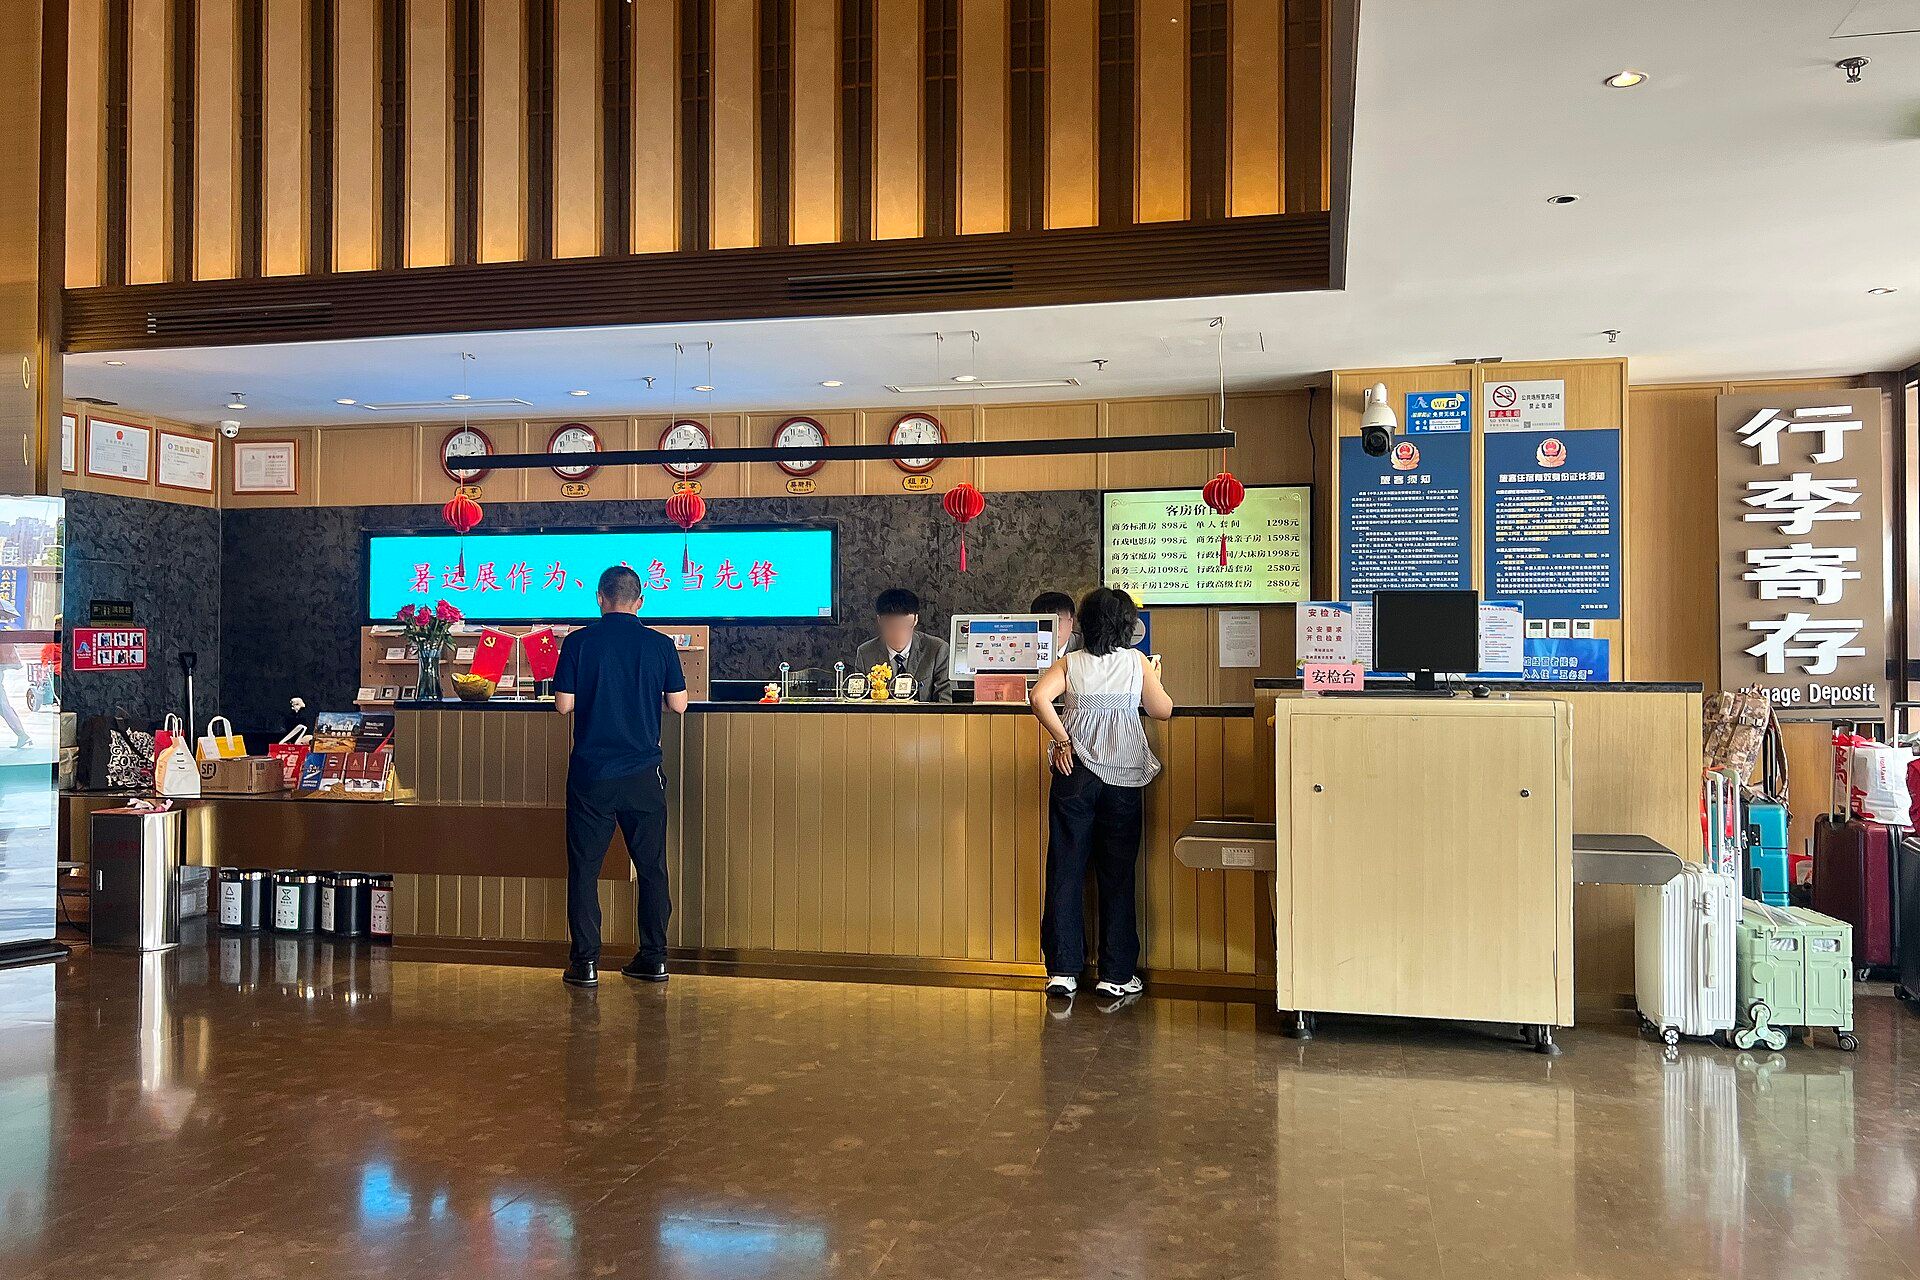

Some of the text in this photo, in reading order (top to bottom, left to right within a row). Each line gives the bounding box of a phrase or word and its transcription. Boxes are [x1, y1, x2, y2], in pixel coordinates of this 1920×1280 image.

[1489, 409, 1520, 418] 禁止吸烟
[1379, 474, 1431, 485] 旅客须知
[1161, 521, 1188, 530] 898元
[1266, 519, 1300, 527] 1298元
[1161, 537, 1188, 545] 998元
[1267, 533, 1300, 542] 1598元
[1735, 405, 1866, 676] 行李寄存
[1161, 551, 1188, 560] 998元
[1267, 563, 1300, 572] 2580元
[408, 558, 779, 594] 暑运展作为、急当先锋
[1267, 578, 1300, 587] 2880元
[1308, 608, 1342, 618] 安检台
[1312, 669, 1356, 684] 安检台
[1809, 683, 1876, 706] Deposit
